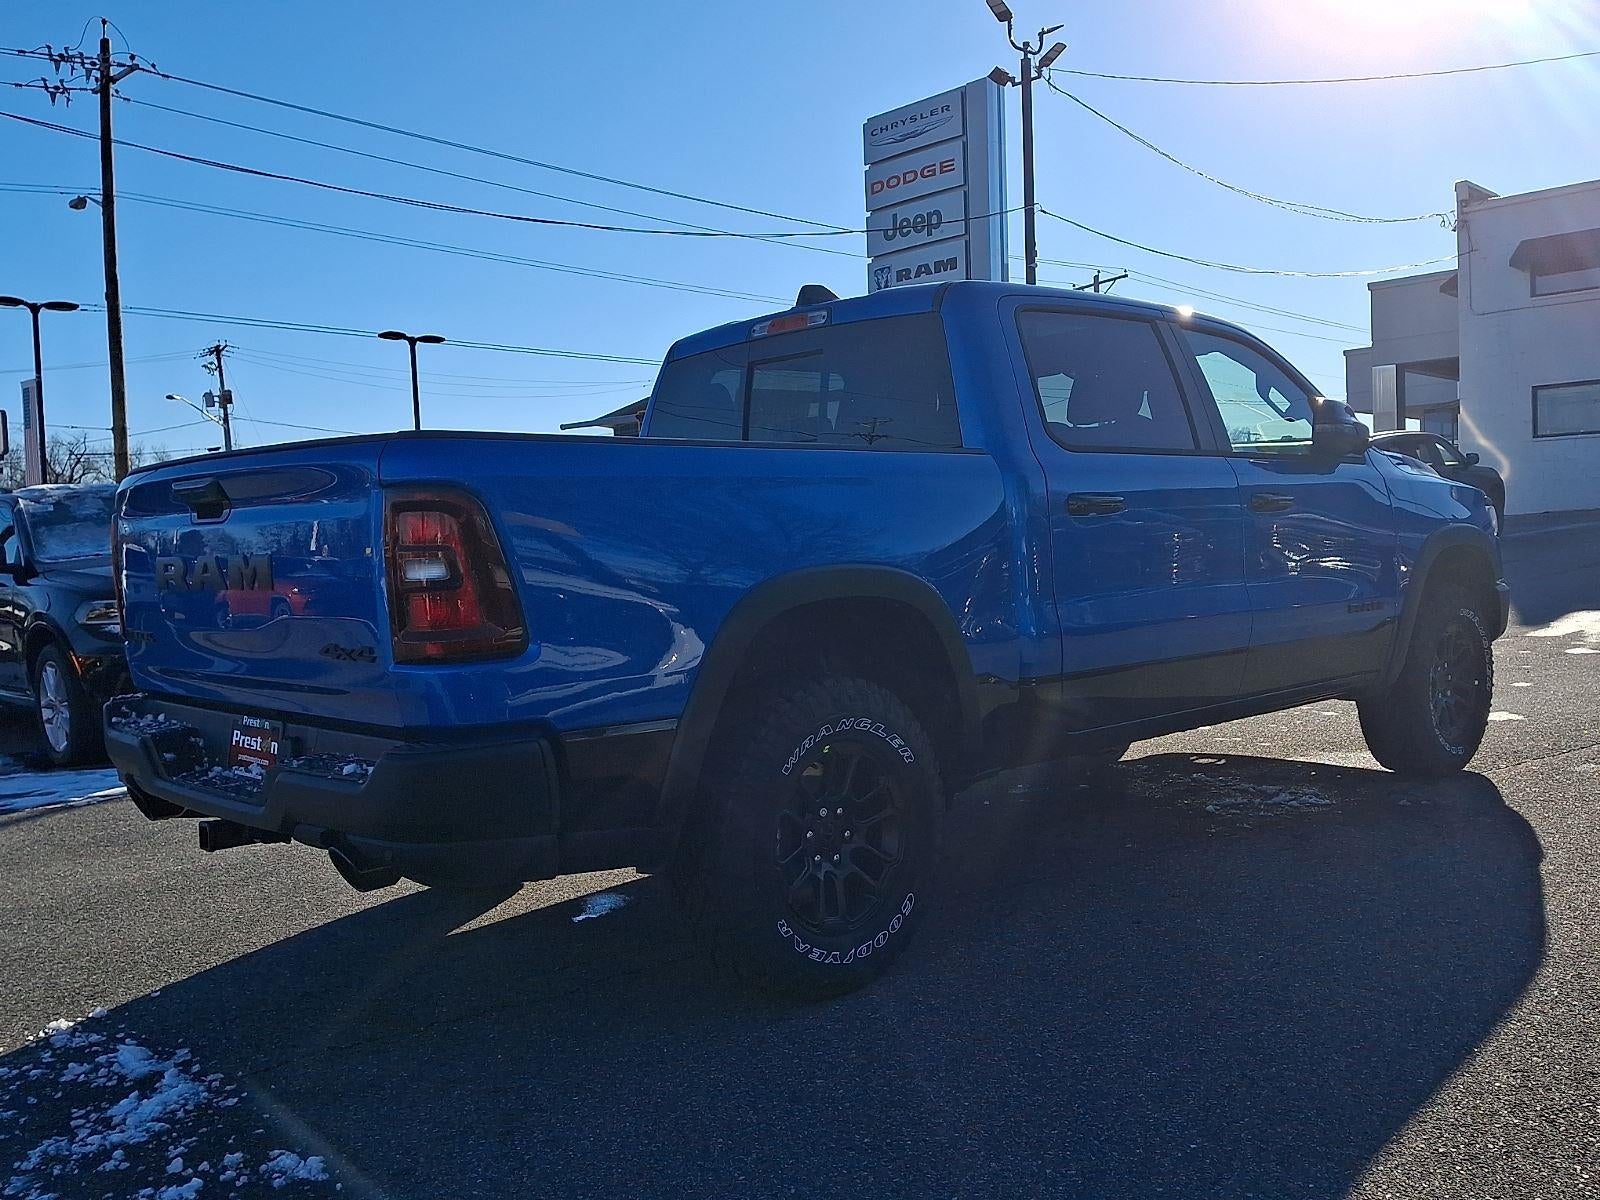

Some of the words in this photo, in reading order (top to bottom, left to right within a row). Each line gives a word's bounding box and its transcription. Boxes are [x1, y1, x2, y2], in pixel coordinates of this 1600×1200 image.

[870, 104, 951, 137] CHRYSLER
[870, 157, 956, 196] DODGE
[882, 209, 943, 242] Jeep
[895, 256, 958, 283] RAM
[155, 553, 274, 592] RAM
[231, 729, 279, 755] Preston
[781, 717, 915, 775] WRANGLER
[777, 893, 915, 964] GOODYEAR
